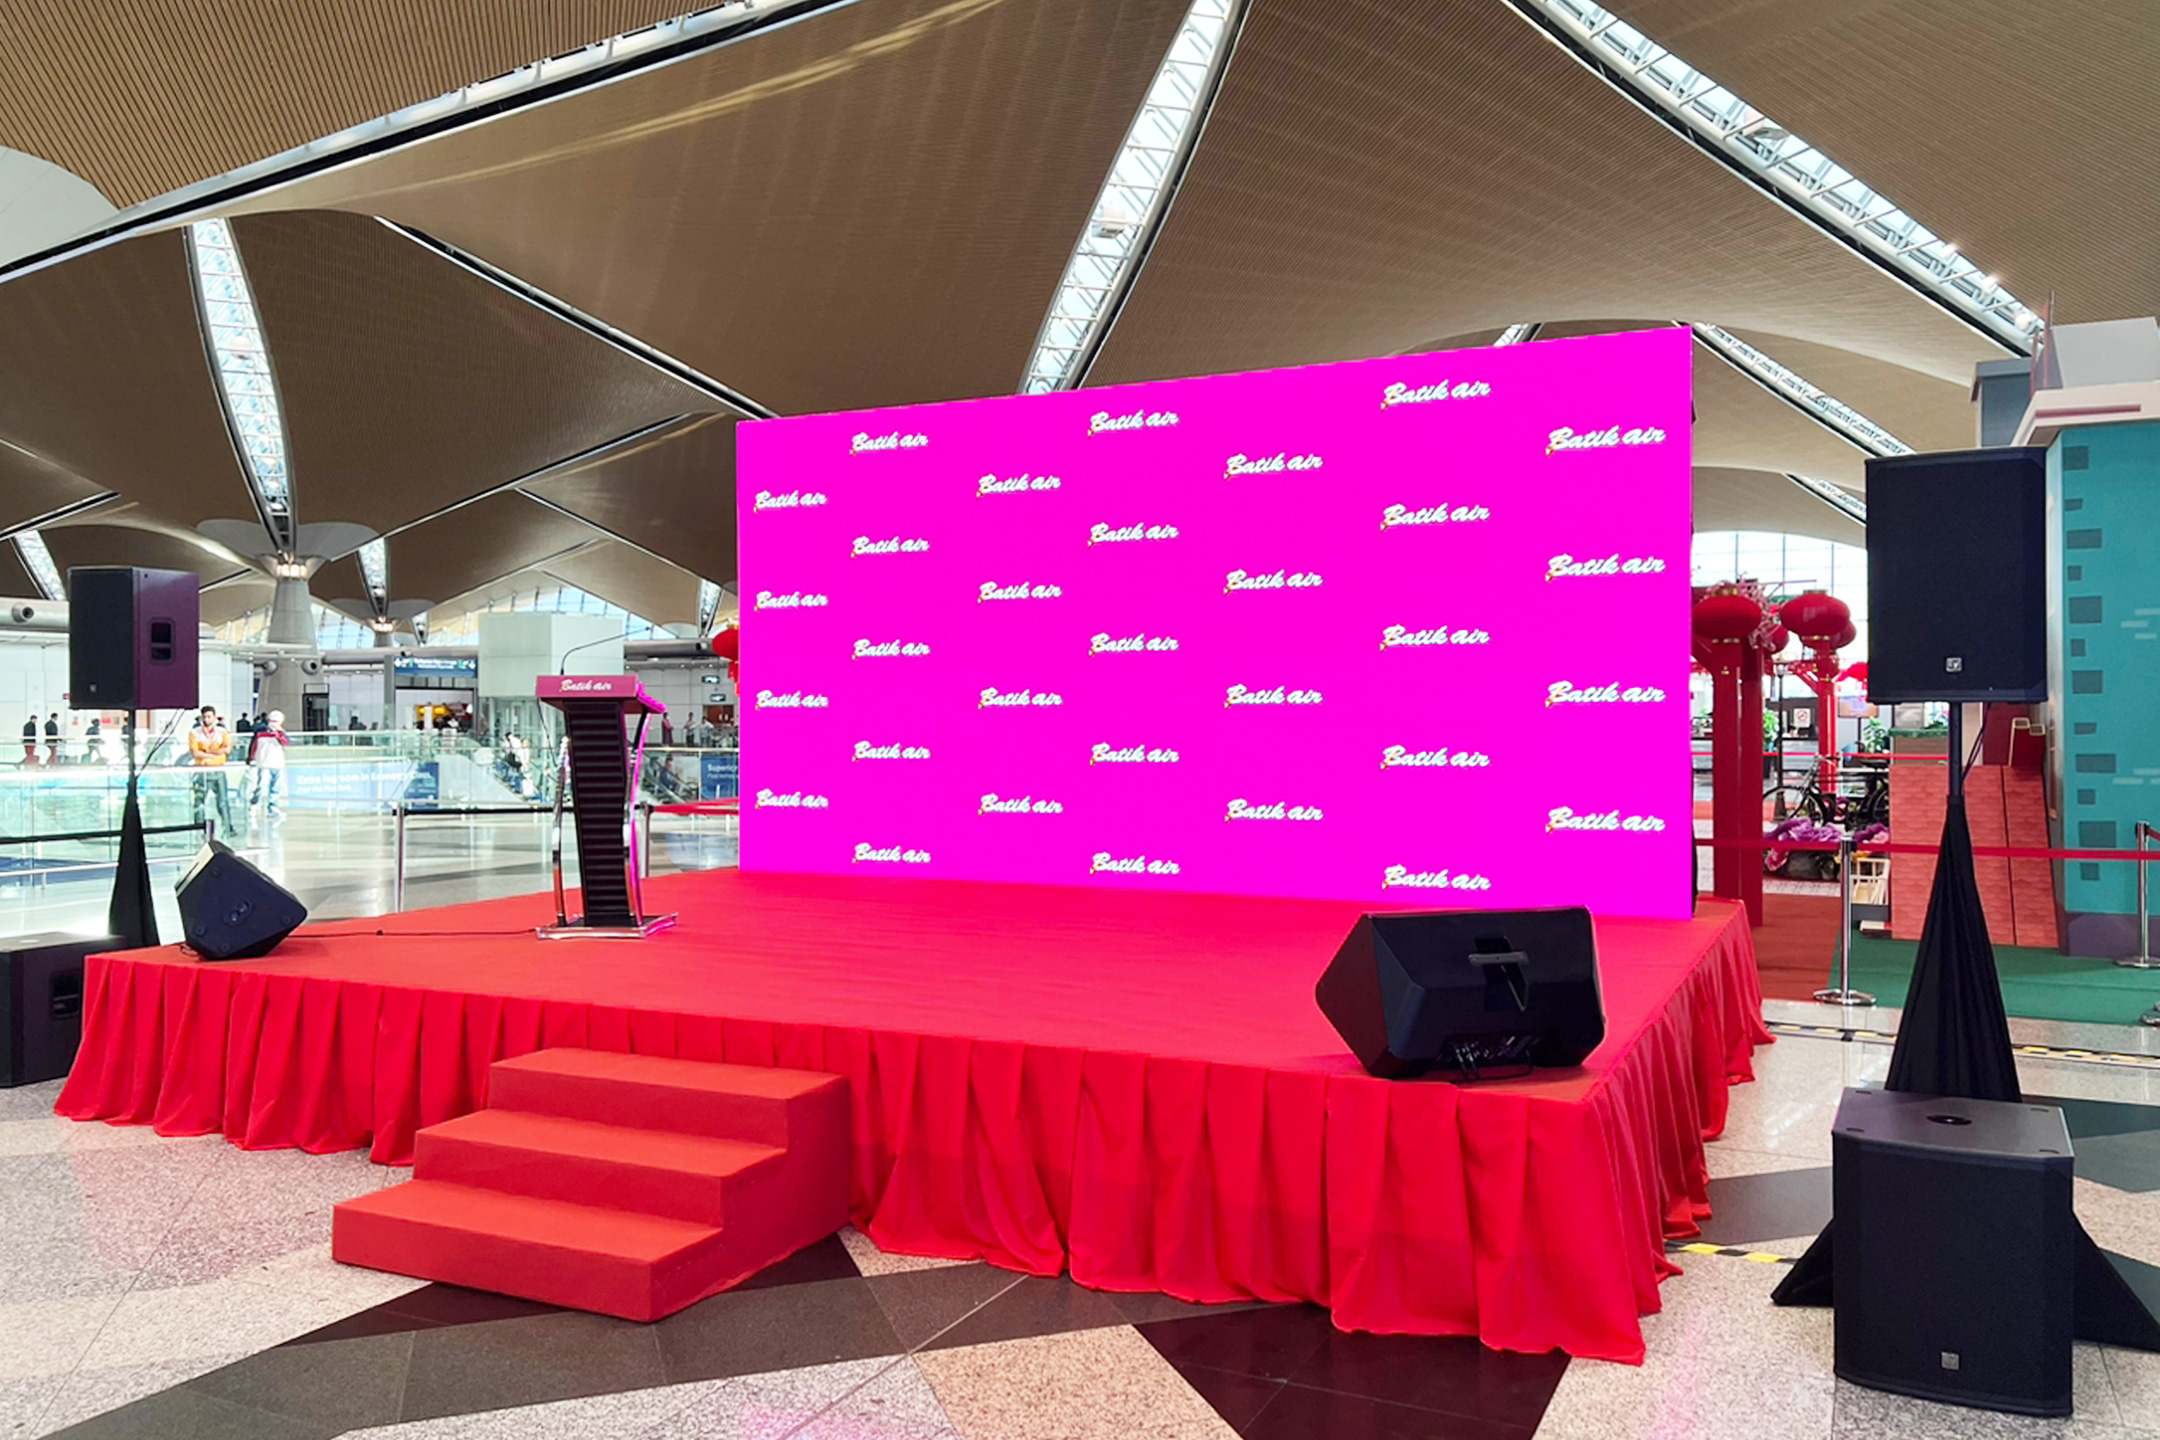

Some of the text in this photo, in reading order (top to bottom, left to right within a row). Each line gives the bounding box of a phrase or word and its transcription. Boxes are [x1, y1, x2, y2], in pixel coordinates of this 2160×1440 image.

[1381, 380, 1491, 409] Batik air
[1088, 410, 1179, 435] Batik air
[850, 432, 928, 454] Batik air
[1546, 425, 1665, 455] Batik air
[1224, 453, 1323, 478] Batik air
[977, 474, 1061, 497] Batik air
[754, 490, 827, 512] Batik air
[1380, 503, 1490, 529] Batik air
[1088, 523, 1178, 545] Batik air
[851, 536, 929, 557] Batik air
[1545, 554, 1665, 581] Batik air
[1224, 569, 1323, 593] Batik air
[754, 591, 828, 610] Batik air
[978, 582, 1062, 603] Batik air
[1089, 633, 1178, 655] Batik air
[1380, 624, 1490, 650] Batik air
[852, 639, 930, 659] Batik air
[755, 690, 828, 709] Batik air
[978, 687, 1062, 708] Batik air
[1225, 684, 1322, 707] Batik air
[1545, 681, 1665, 707] Batik air
[852, 741, 930, 761] Batik air
[1090, 742, 1179, 765] Batik air
[1381, 745, 1489, 769] Batik air
[755, 789, 828, 808] Batik air
[978, 793, 1063, 814] Batik air
[1225, 799, 1323, 821] Batik air
[1546, 806, 1665, 832] Batik air
[853, 843, 931, 862] Batik air
[1090, 852, 1180, 874] Batik air
[1382, 864, 1491, 890] Batik air
